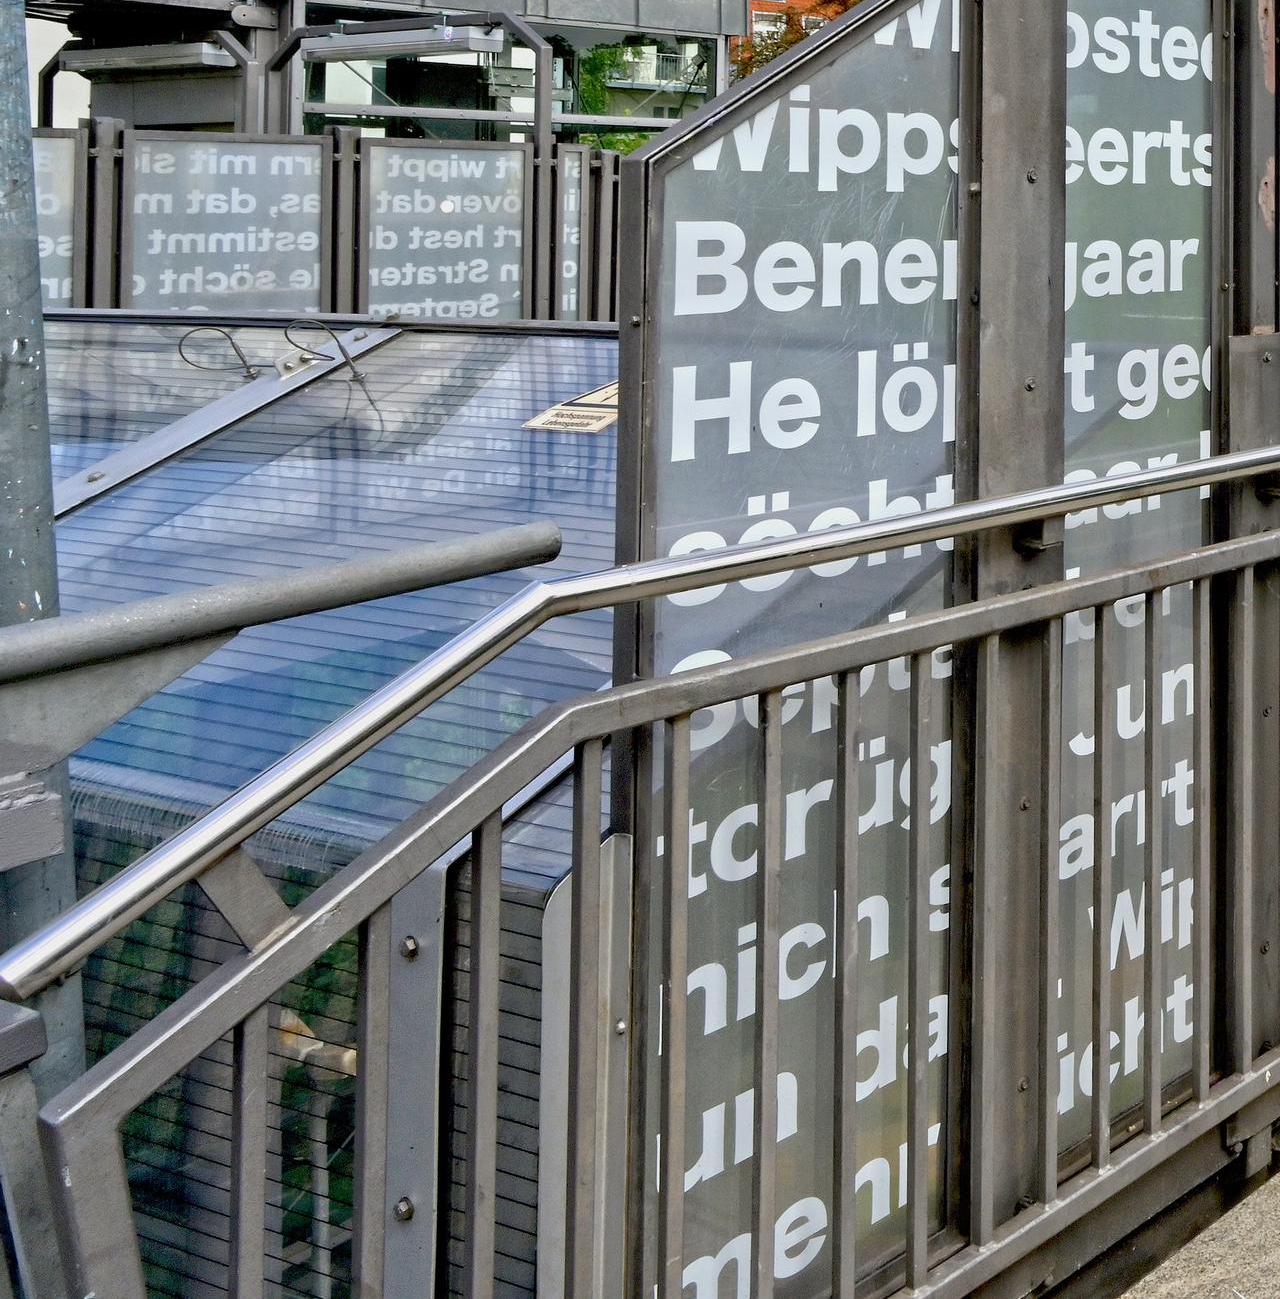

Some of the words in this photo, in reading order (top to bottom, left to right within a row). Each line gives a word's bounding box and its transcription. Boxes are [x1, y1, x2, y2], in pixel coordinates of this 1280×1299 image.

[692, 85, 959, 192] Wipp
[671, 361, 821, 462] He
[856, 342, 956, 442] lö
